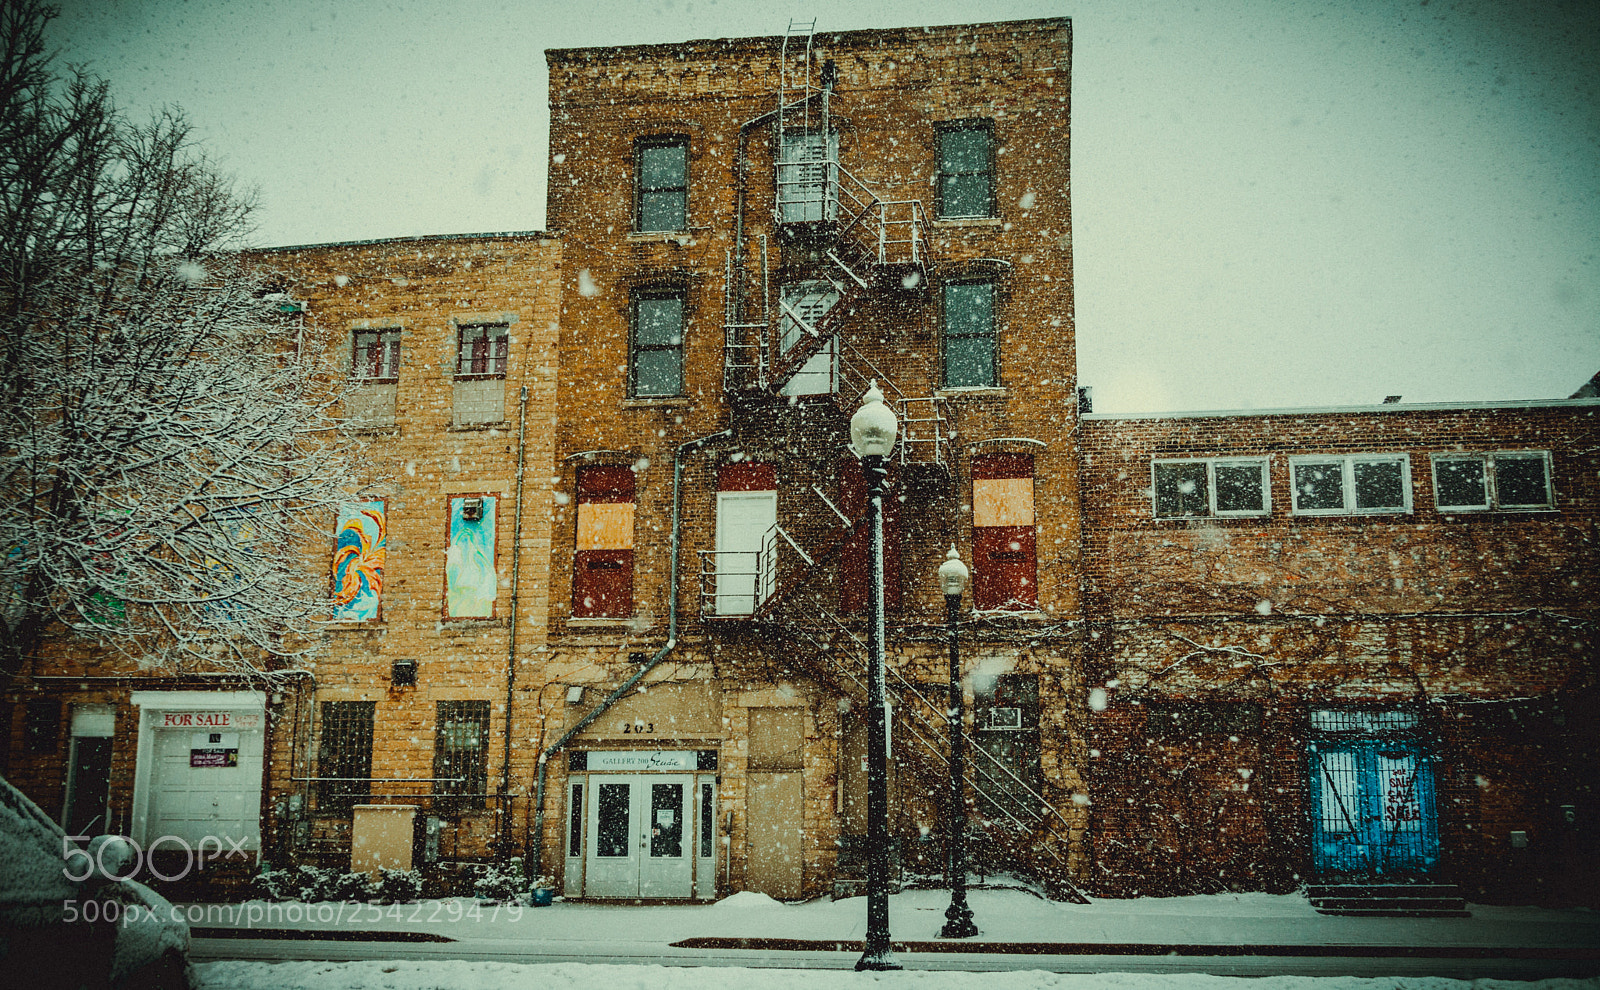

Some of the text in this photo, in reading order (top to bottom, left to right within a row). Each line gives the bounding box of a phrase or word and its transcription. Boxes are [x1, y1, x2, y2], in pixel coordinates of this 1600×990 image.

[164, 713, 192, 726] FOR
[195, 713, 231, 726] SALE
[624, 723, 654, 734] 203
